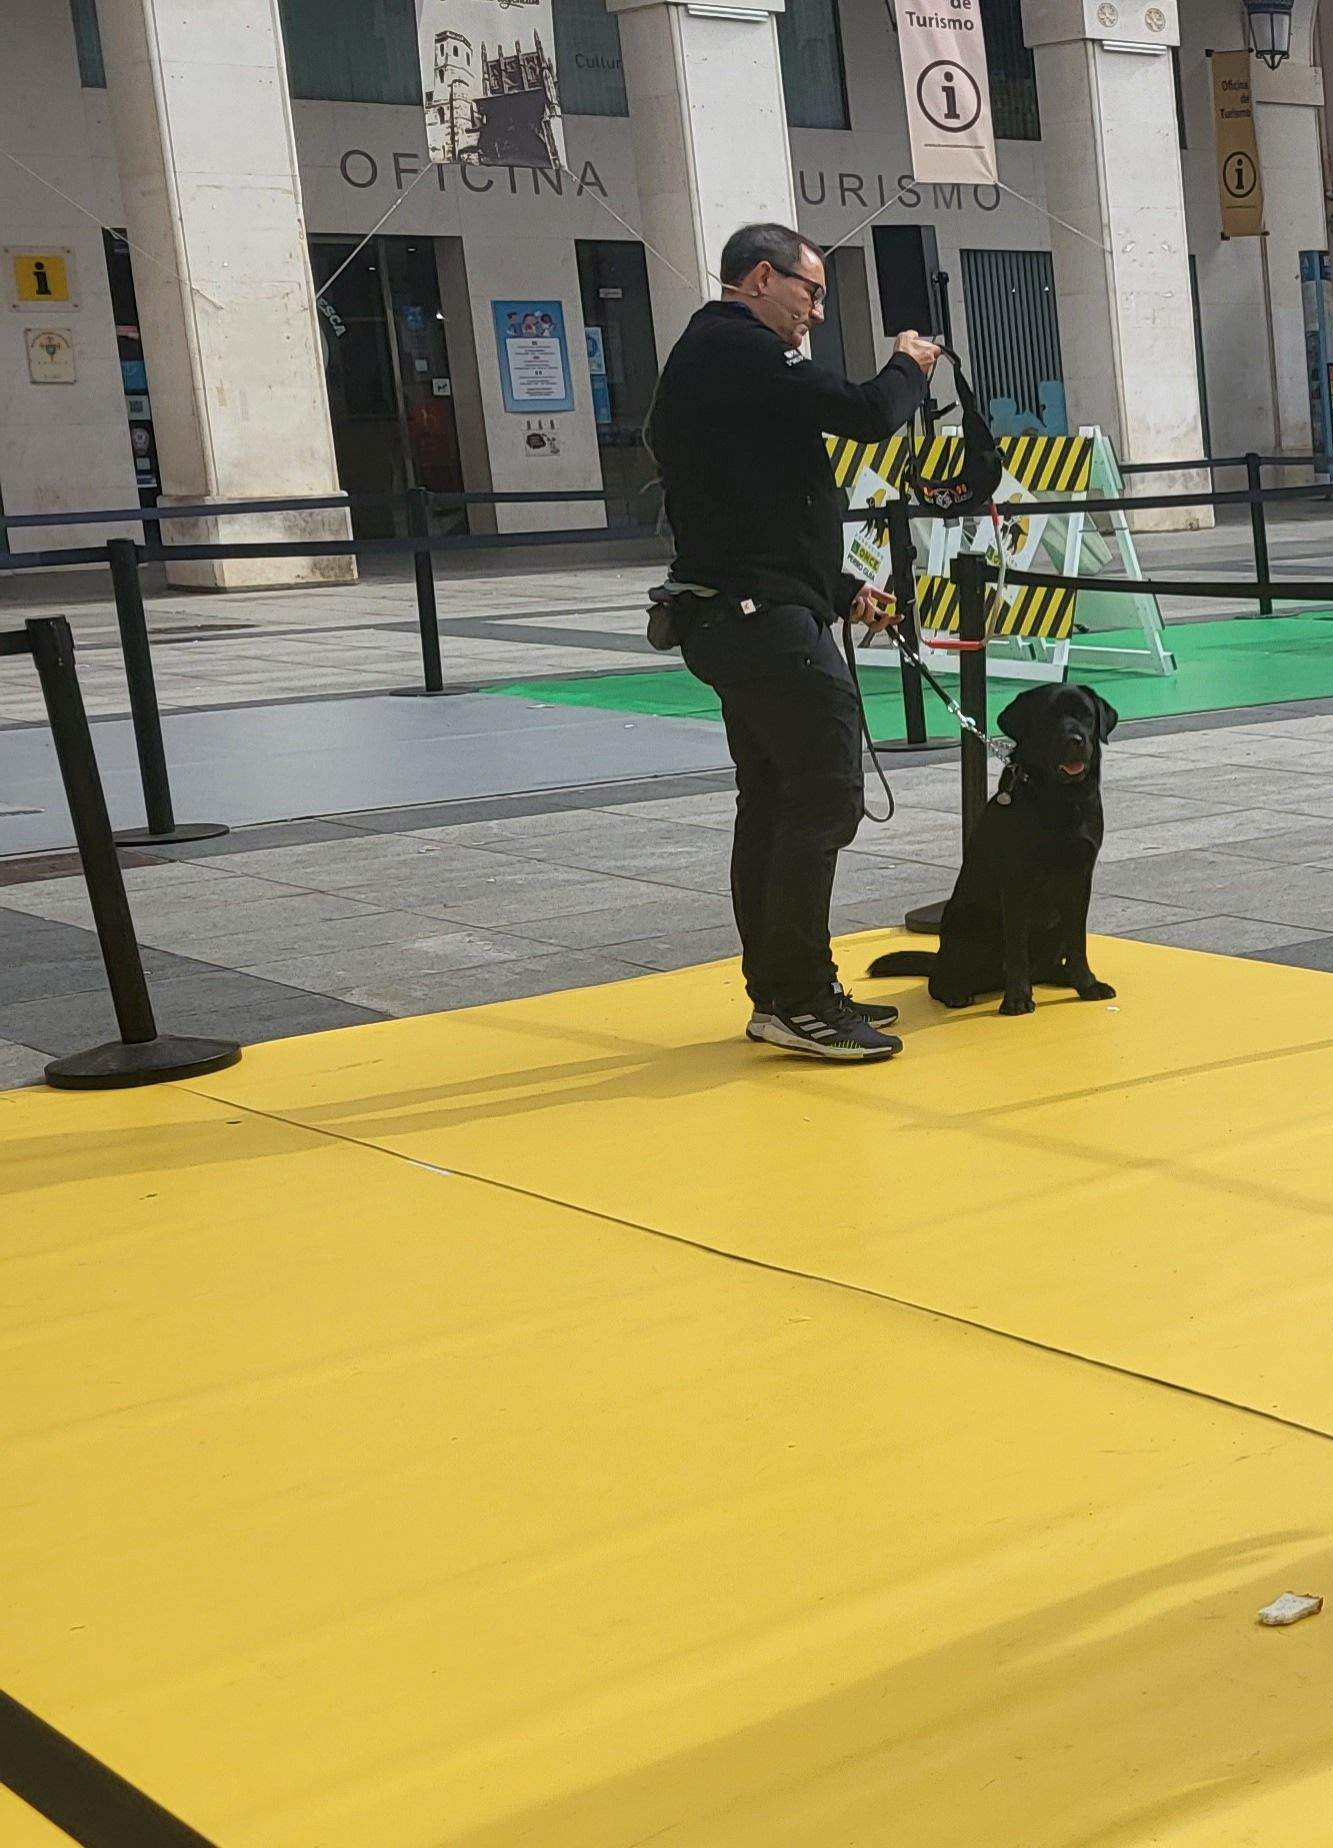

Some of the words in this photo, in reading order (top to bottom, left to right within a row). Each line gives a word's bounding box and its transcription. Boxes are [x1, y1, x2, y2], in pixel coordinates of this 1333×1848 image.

[905, 11, 974, 31] Turismo
[340, 149, 608, 198] OFICINA
[859, 546, 881, 572] ONCE
